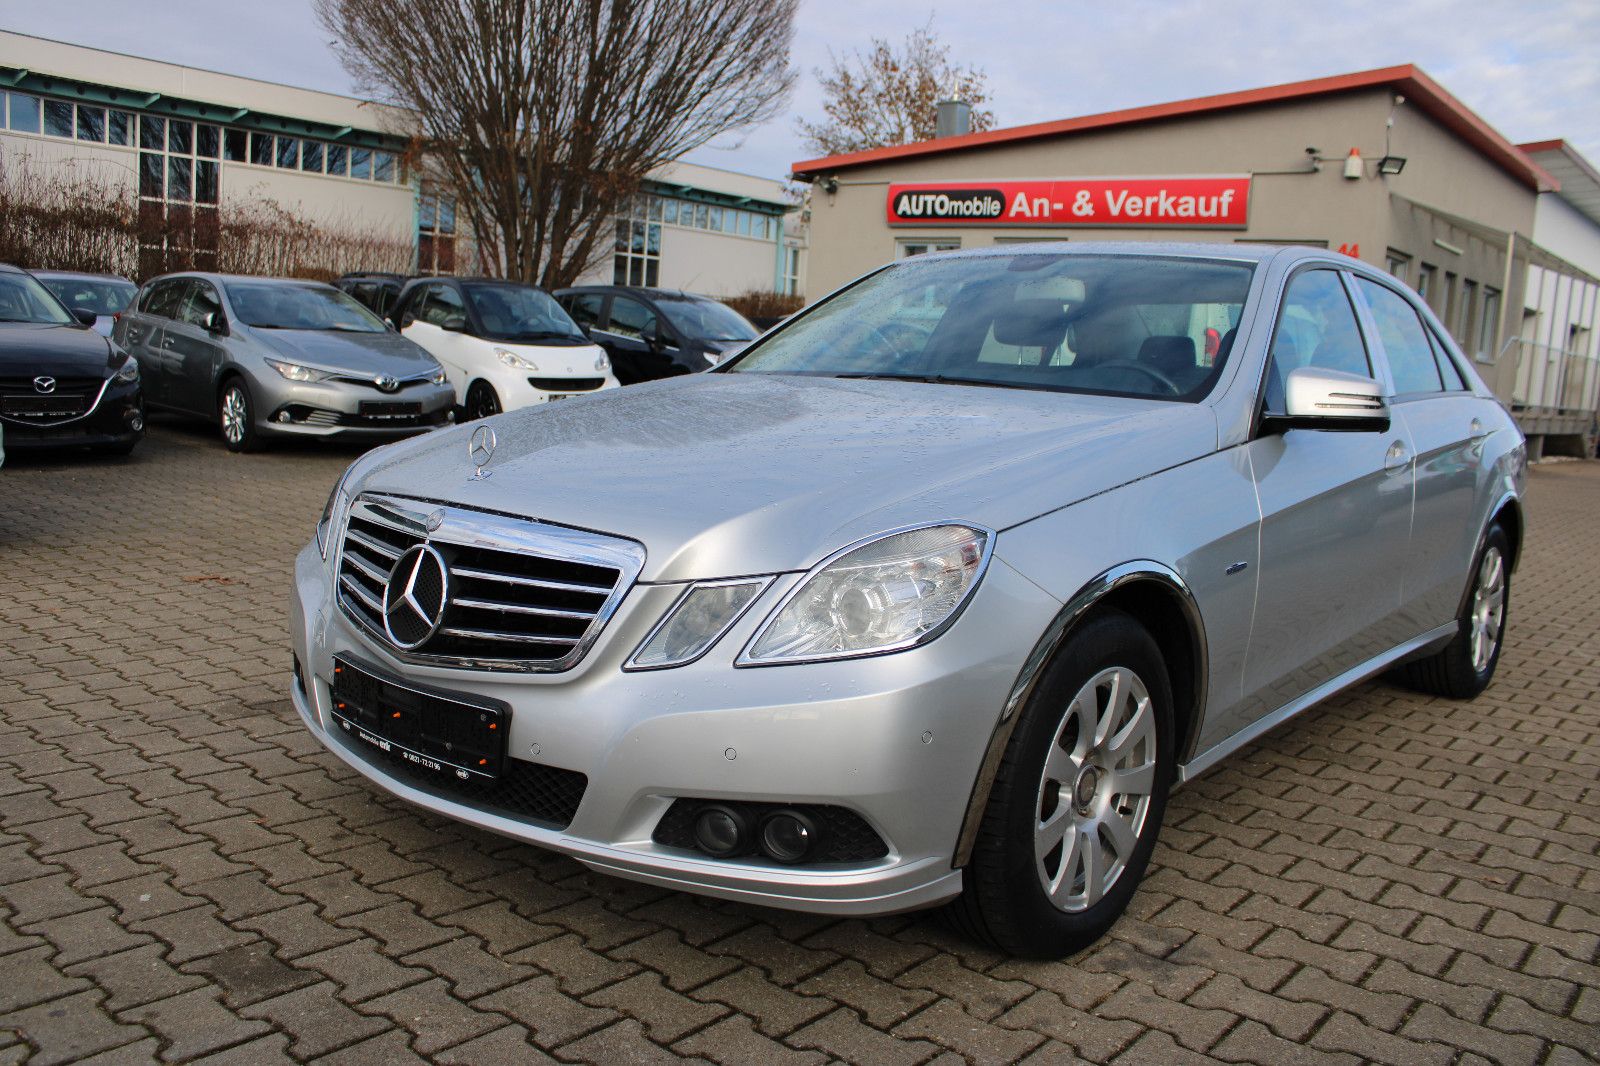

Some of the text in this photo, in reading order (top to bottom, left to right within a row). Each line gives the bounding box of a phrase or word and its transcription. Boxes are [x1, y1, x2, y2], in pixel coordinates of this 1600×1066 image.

[897, 189, 1235, 217] AUTOmobile An- & Verkauf
